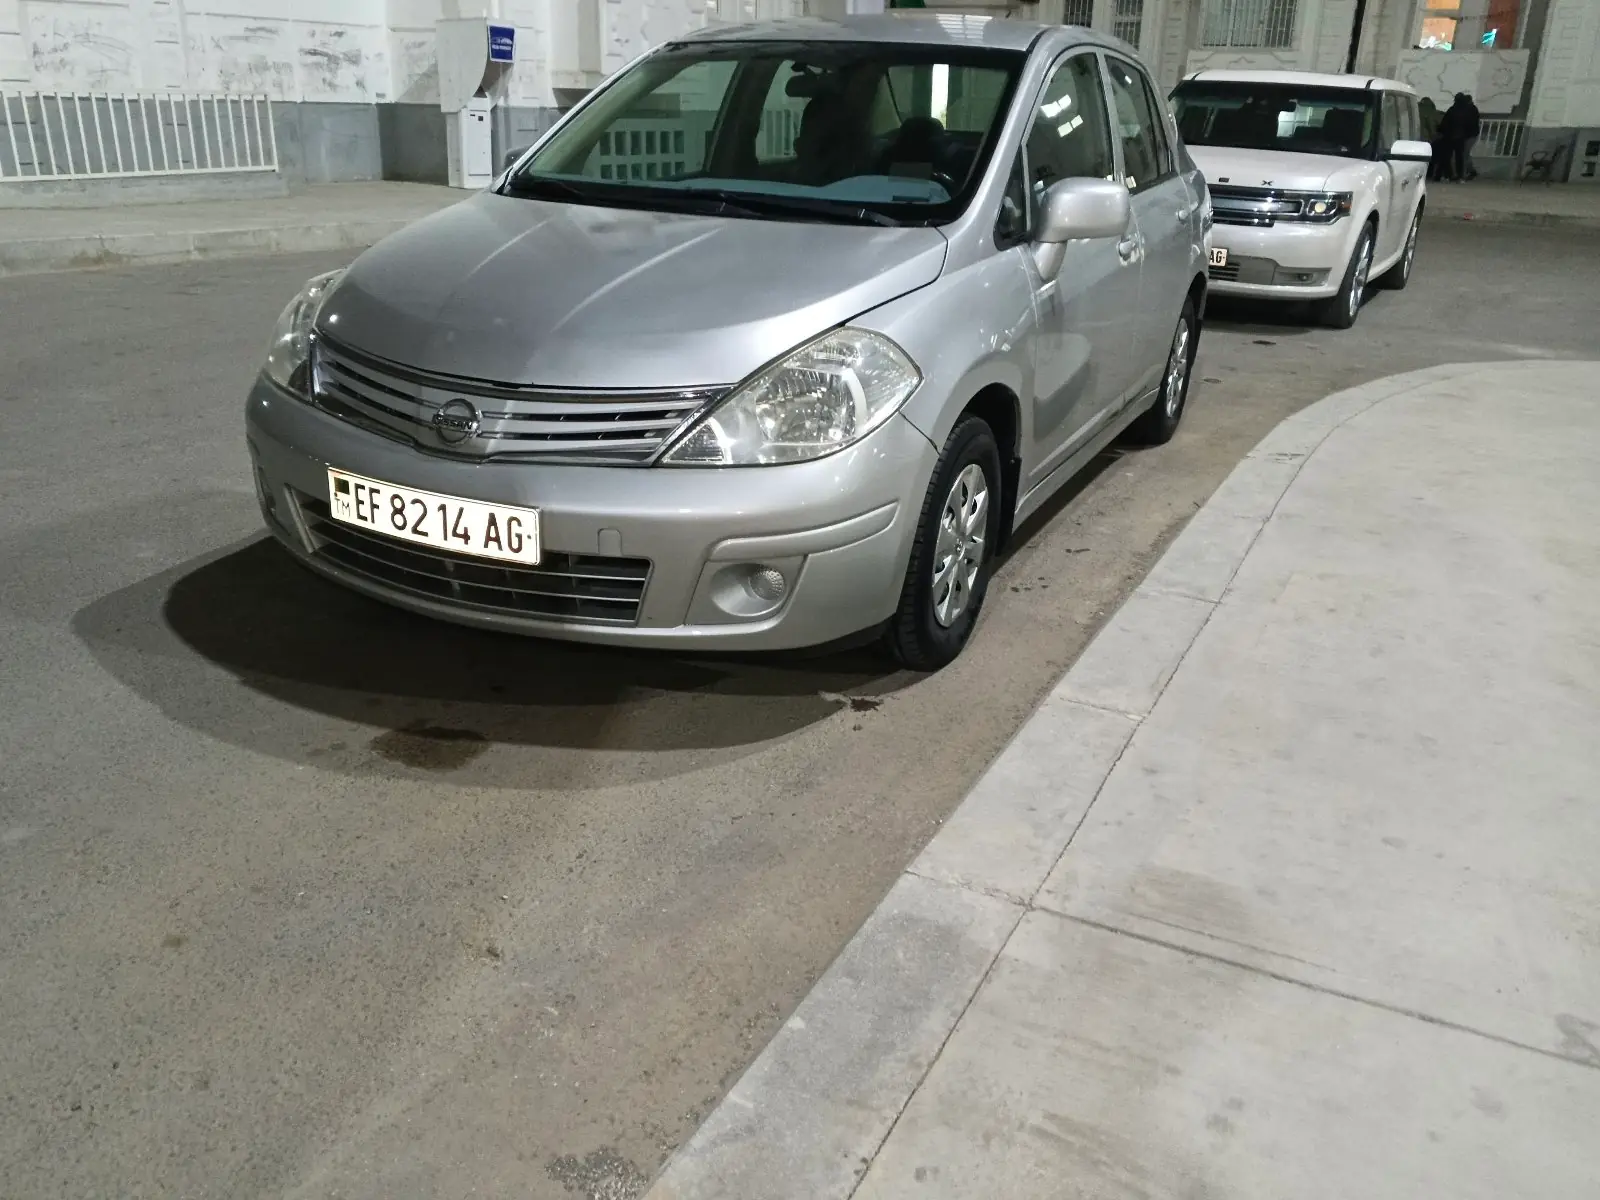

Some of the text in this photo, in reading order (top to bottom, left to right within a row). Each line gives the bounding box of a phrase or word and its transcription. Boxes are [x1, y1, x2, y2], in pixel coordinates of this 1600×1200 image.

[334, 497, 351, 517] TM
[354, 482, 524, 554] EF 8214 AG
